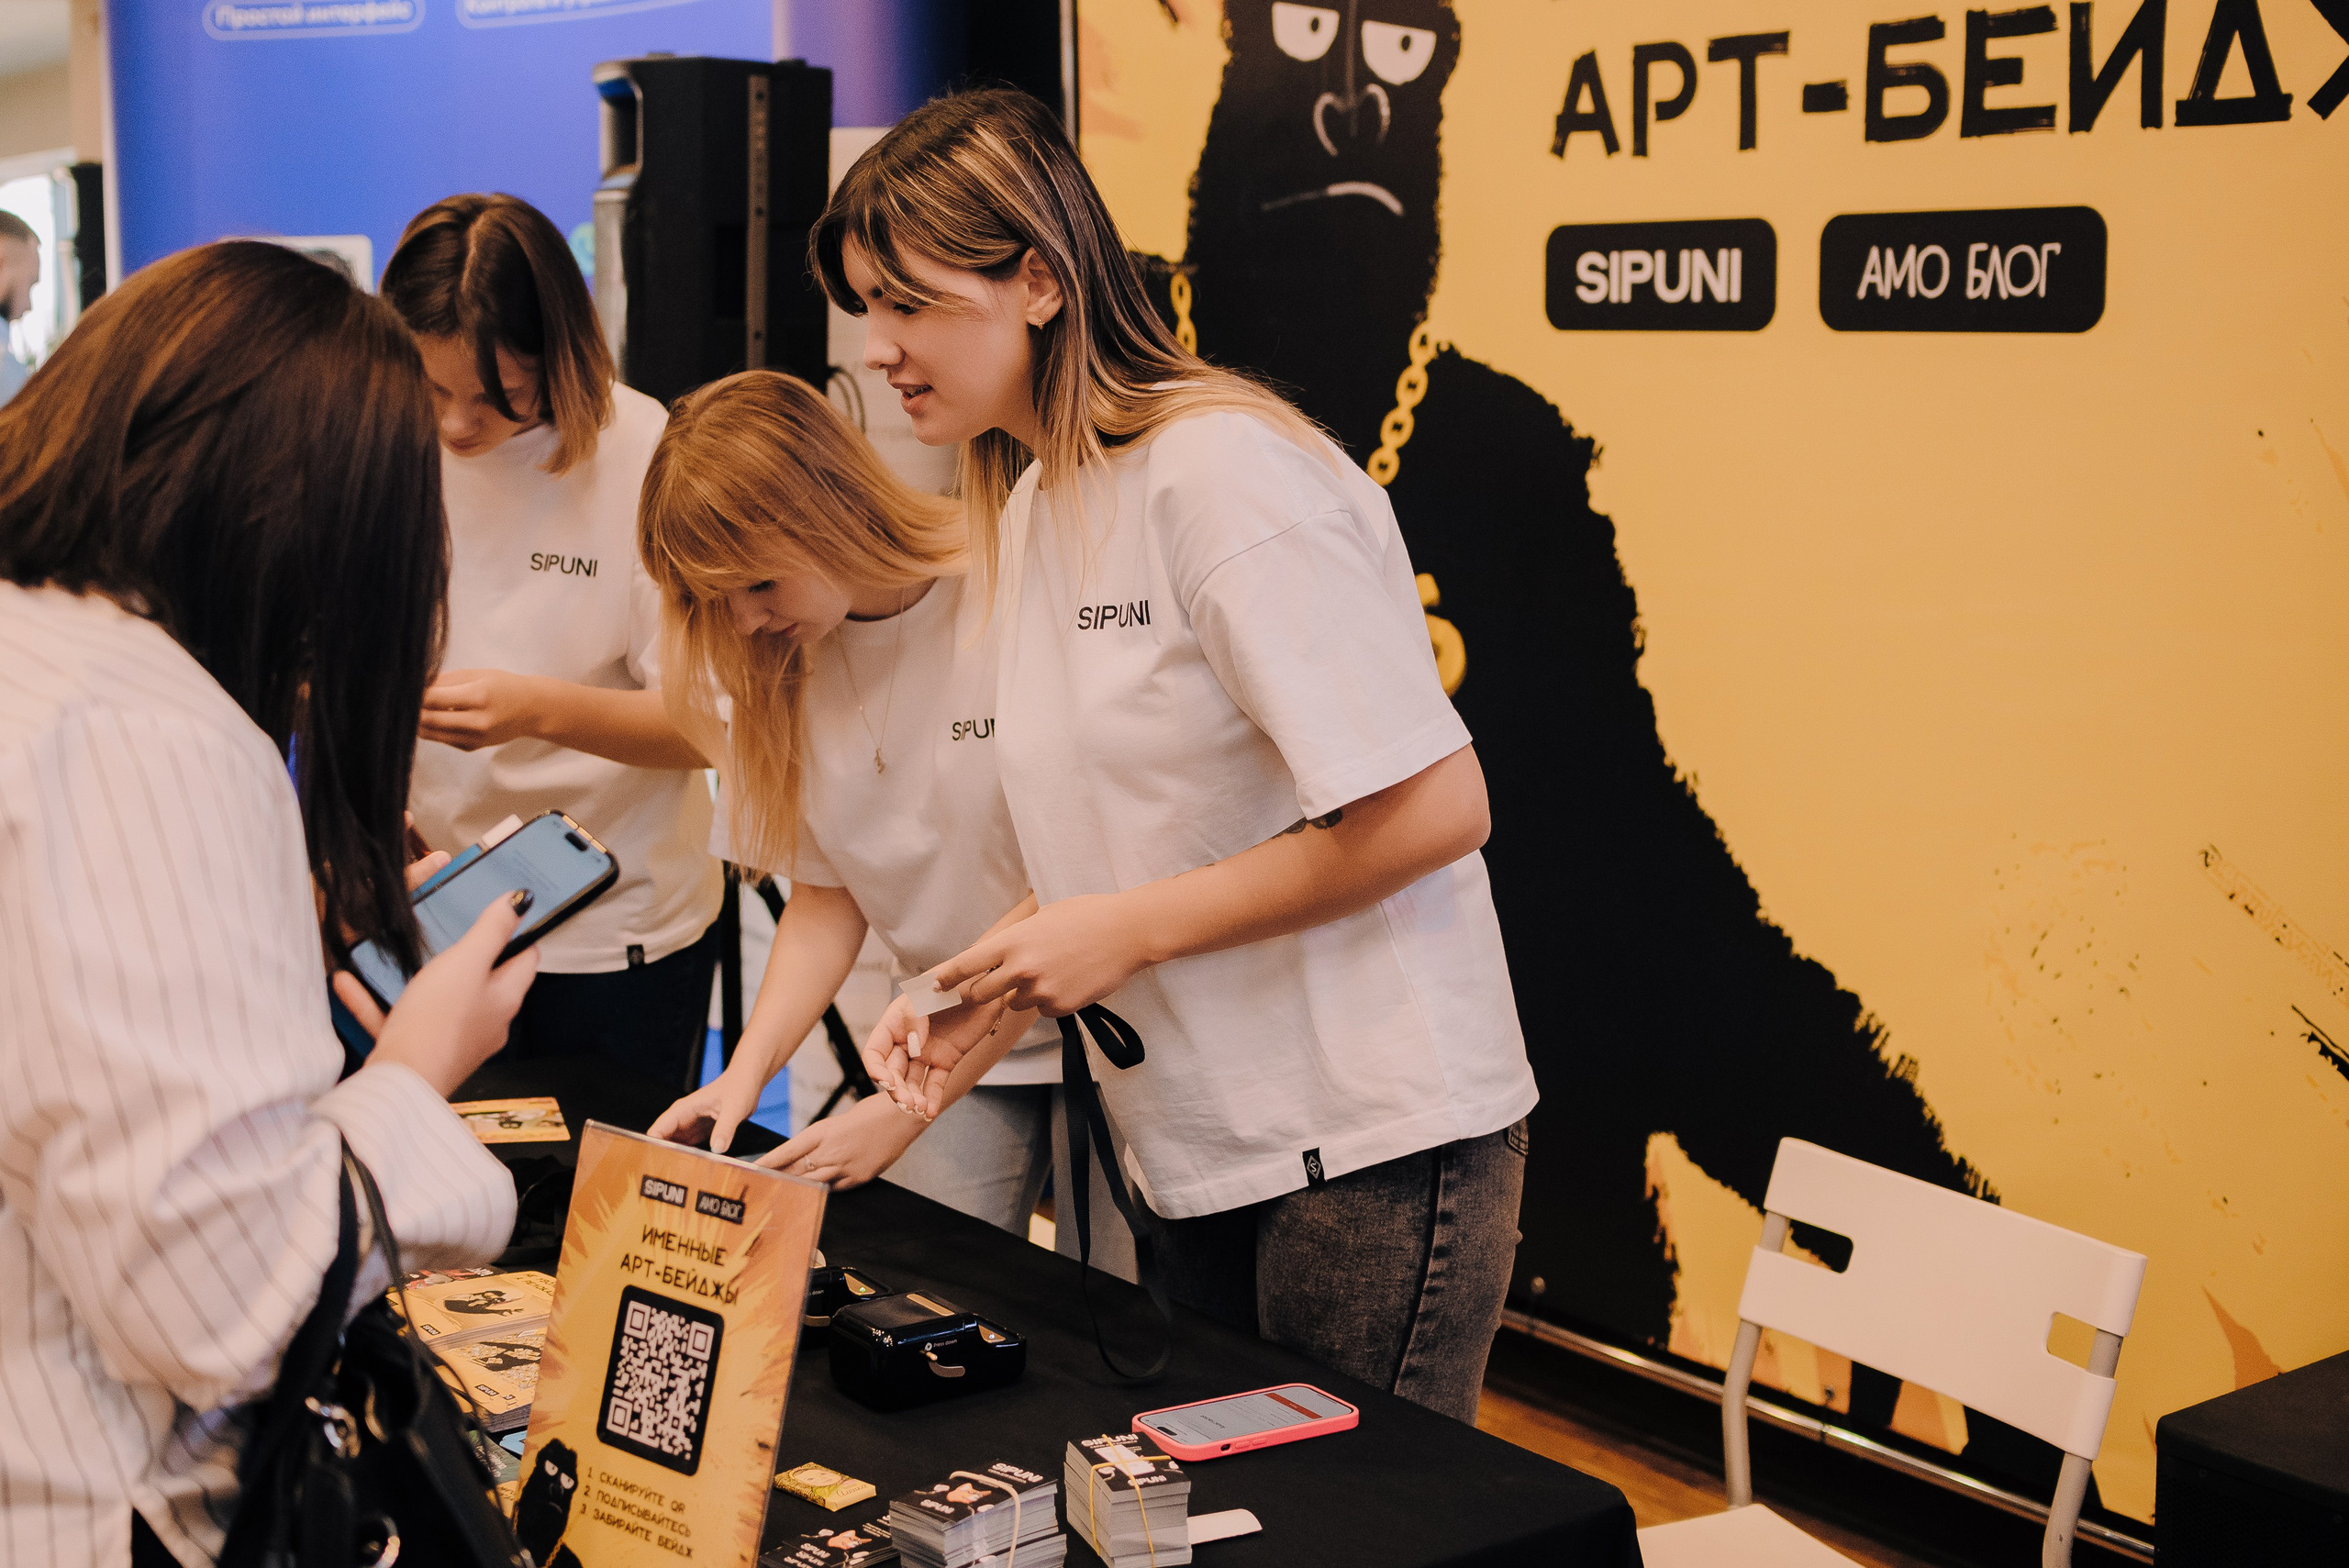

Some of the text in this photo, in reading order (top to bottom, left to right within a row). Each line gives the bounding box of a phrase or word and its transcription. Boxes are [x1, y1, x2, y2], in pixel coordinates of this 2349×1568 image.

[1575, 248, 1742, 305] SIPUNI
[1856, 242, 2063, 301] АМО БЛОГ
[529, 552, 598, 577] SIPUNI
[1076, 599, 1152, 630] SIPUNI
[951, 717, 996, 741] SIPU
[643, 1179, 685, 1205] SIPUNI
[641, 1224, 728, 1267] ИМЕННЫЕ
[477, 1385, 497, 1396] SIPUNI
[992, 1462, 1043, 1484] SIPUNI
[599, 1472, 665, 1507] СКАНИРУЙТЕ
[671, 1499, 686, 1515] QR
[593, 1507, 652, 1542] ЗАБИРАЙТЕ
[596, 1490, 691, 1538] ПОДПИСЫВАЙТЕСЬ
